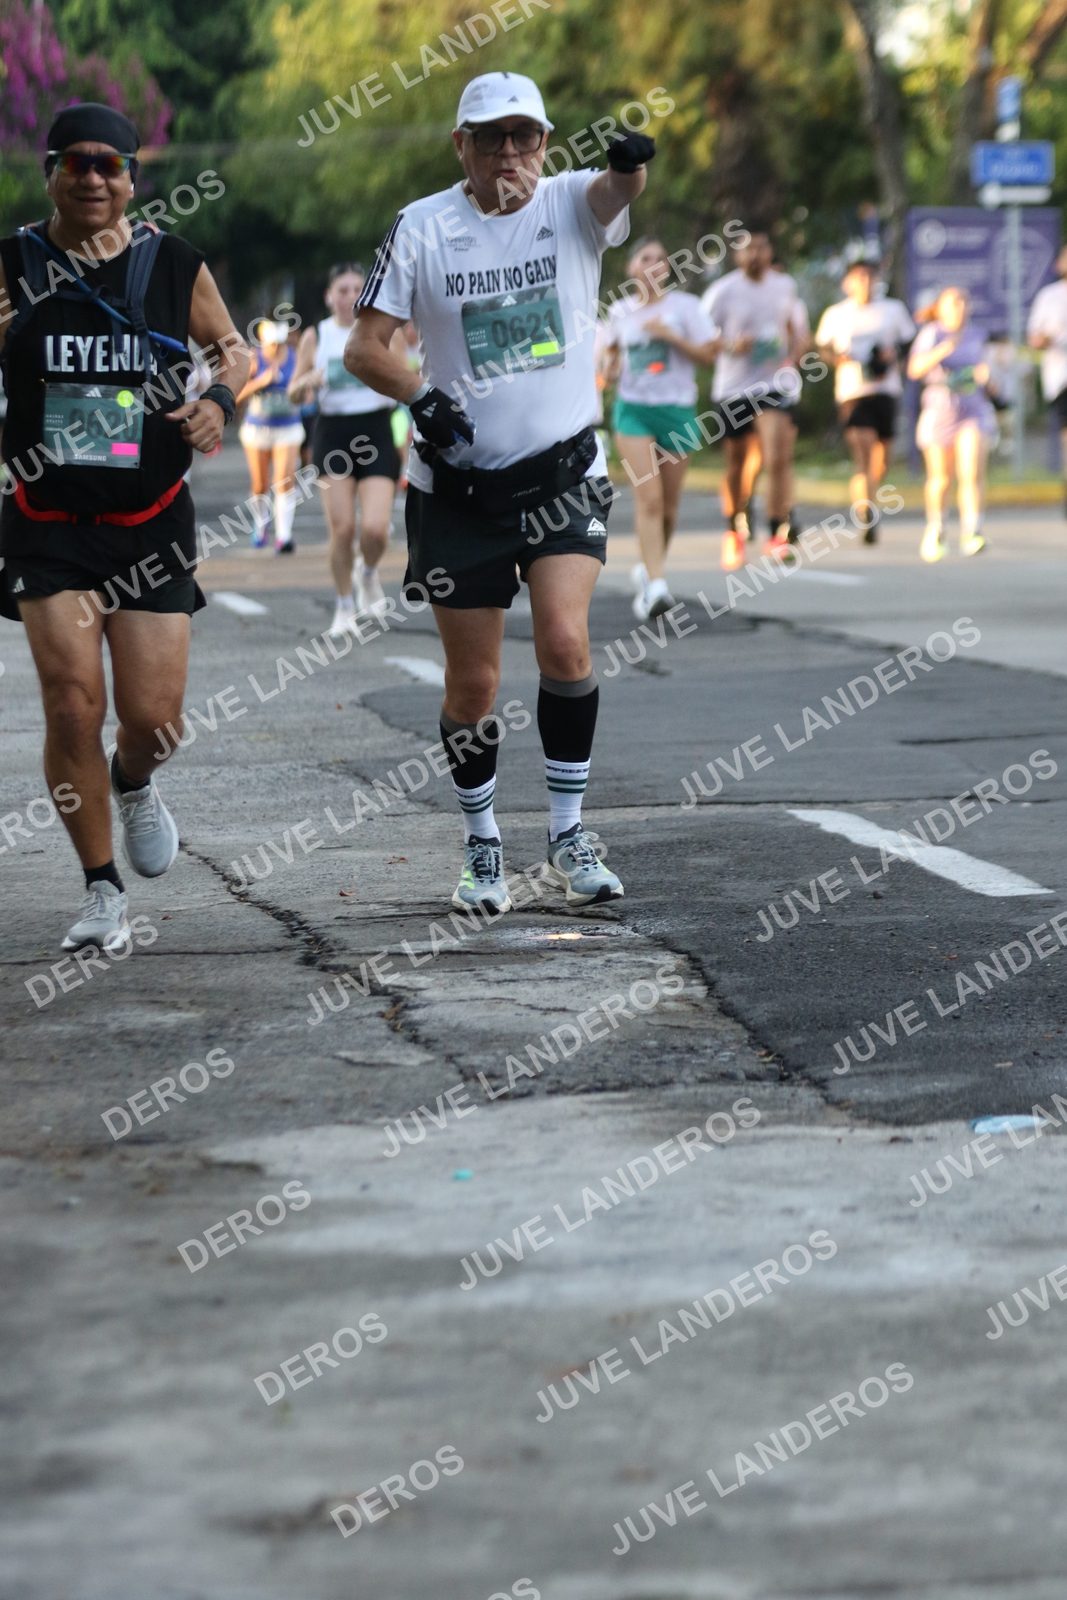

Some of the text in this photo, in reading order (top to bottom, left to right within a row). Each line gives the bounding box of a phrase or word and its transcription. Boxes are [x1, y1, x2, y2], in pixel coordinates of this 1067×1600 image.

[445, 255, 557, 297] NO PAIN NO GAIN
[490, 308, 560, 349] 0621
